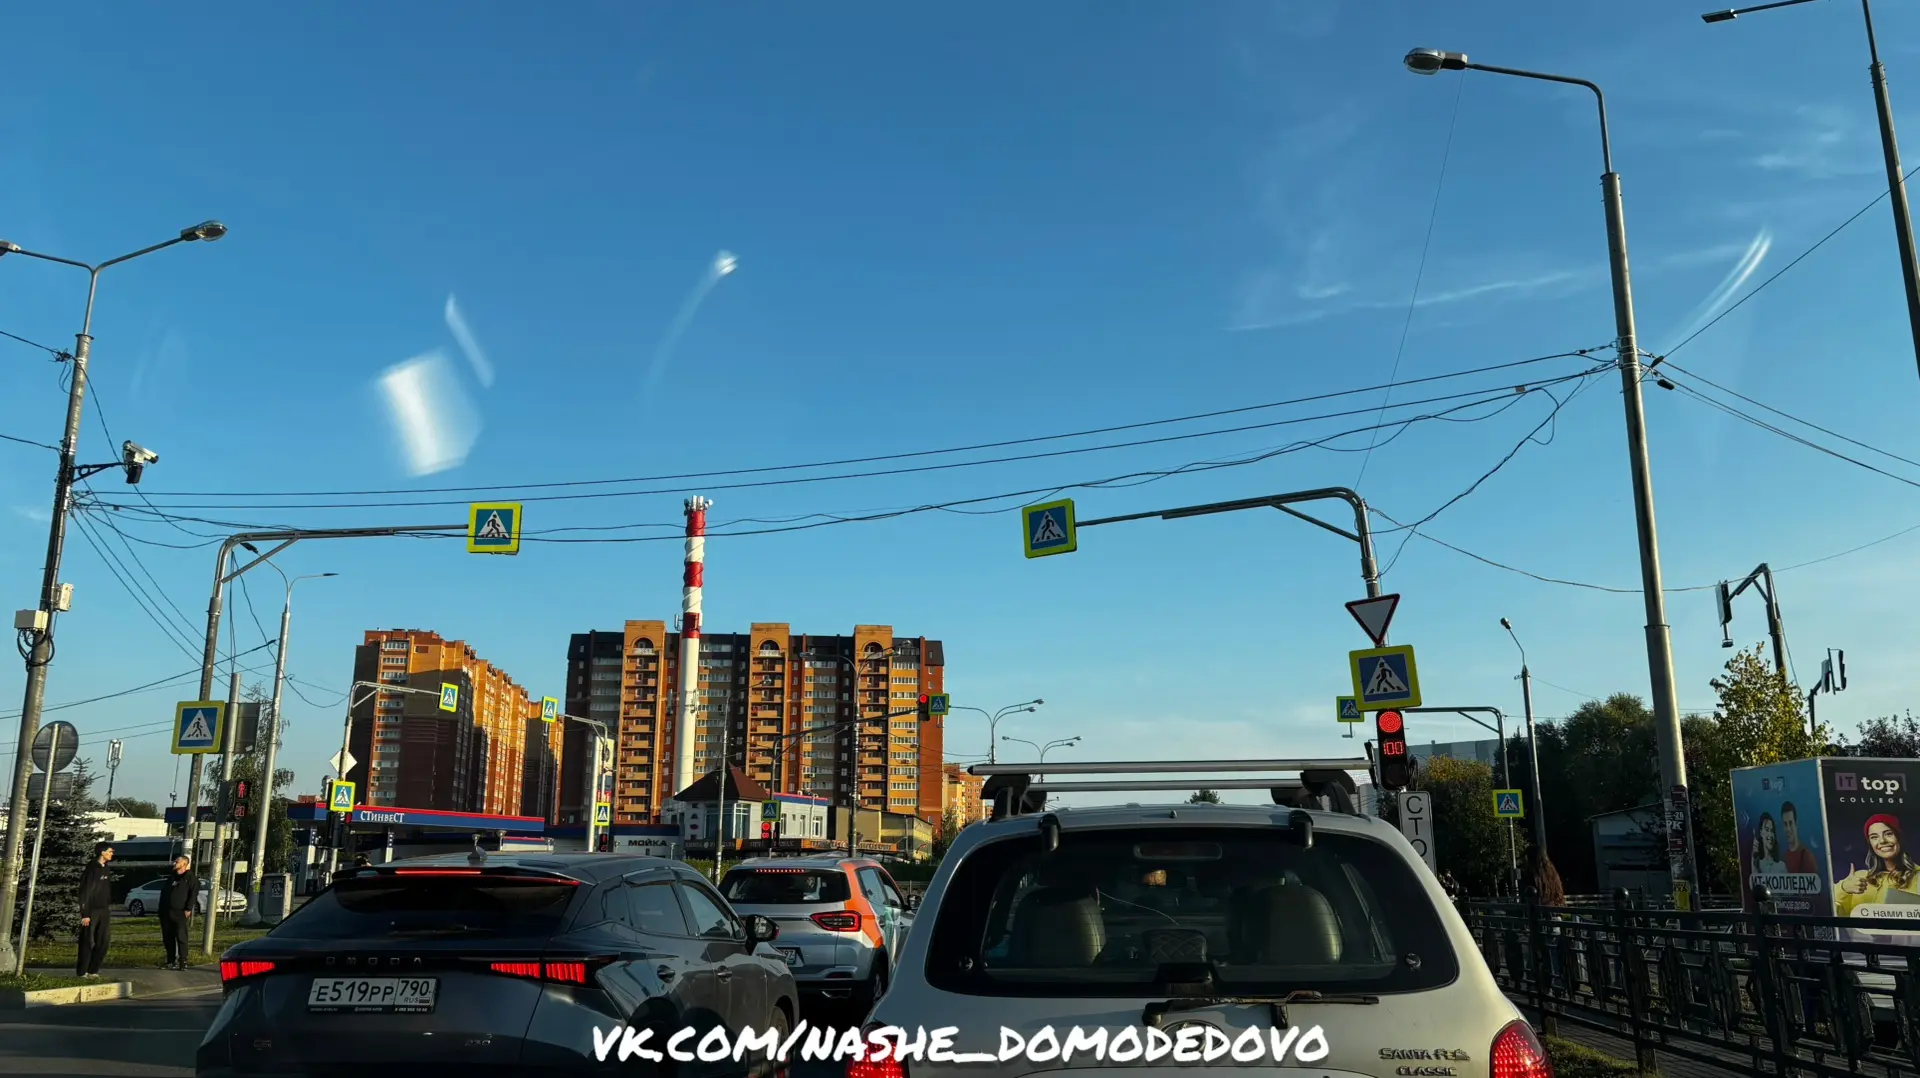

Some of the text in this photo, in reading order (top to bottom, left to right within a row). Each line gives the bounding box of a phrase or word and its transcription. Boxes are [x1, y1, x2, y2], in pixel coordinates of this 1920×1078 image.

[1383, 741, 1404, 755] 100
[1838, 775, 1899, 794] IT top
[1840, 796, 1903, 804] COLLEGE
[1751, 875, 1817, 892] ИТ-КОЛЛЕДЖ
[1860, 907, 1870, 917] С
[1873, 910, 1903, 918] нами
[316, 981, 430, 1002] Е519РР 790
[1379, 1048, 1432, 1060] SANTA
[1396, 1066, 1457, 1076] CLASSIC
